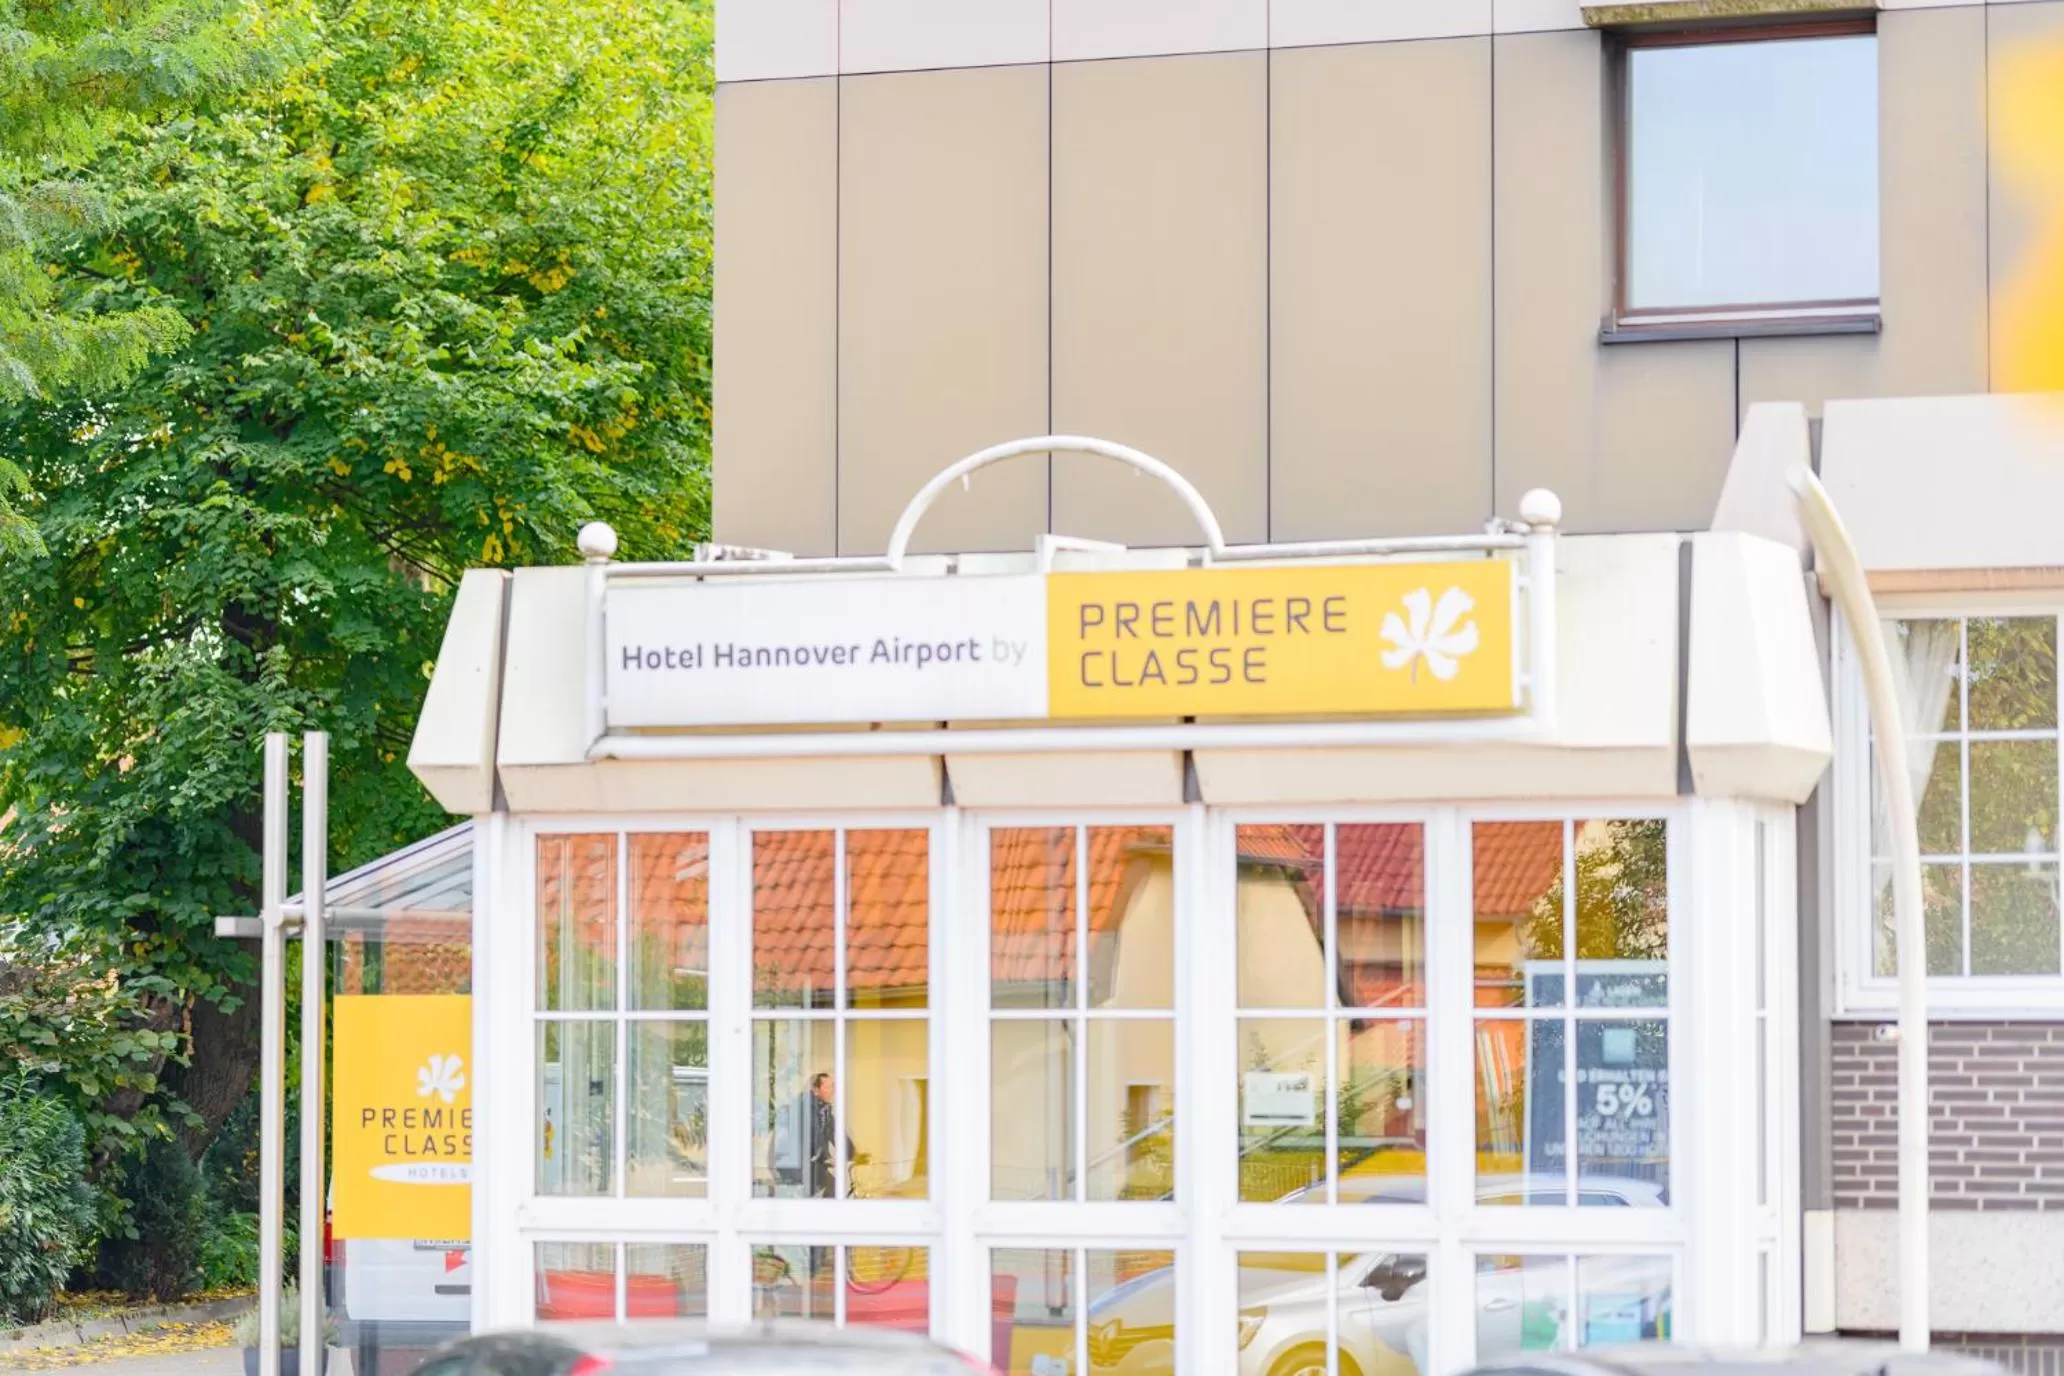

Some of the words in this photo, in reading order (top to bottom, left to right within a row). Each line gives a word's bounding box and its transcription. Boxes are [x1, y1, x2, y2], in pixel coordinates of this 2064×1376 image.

[1079, 595, 1347, 640] PREMIERE
[621, 642, 703, 671] Hotel
[713, 641, 861, 668] Hannover
[869, 636, 981, 670] Airport
[991, 635, 1028, 668] by
[1080, 646, 1267, 688] CLASSE
[1596, 1083, 1653, 1120] 5%
[407, 1167, 469, 1179] HOTELS
